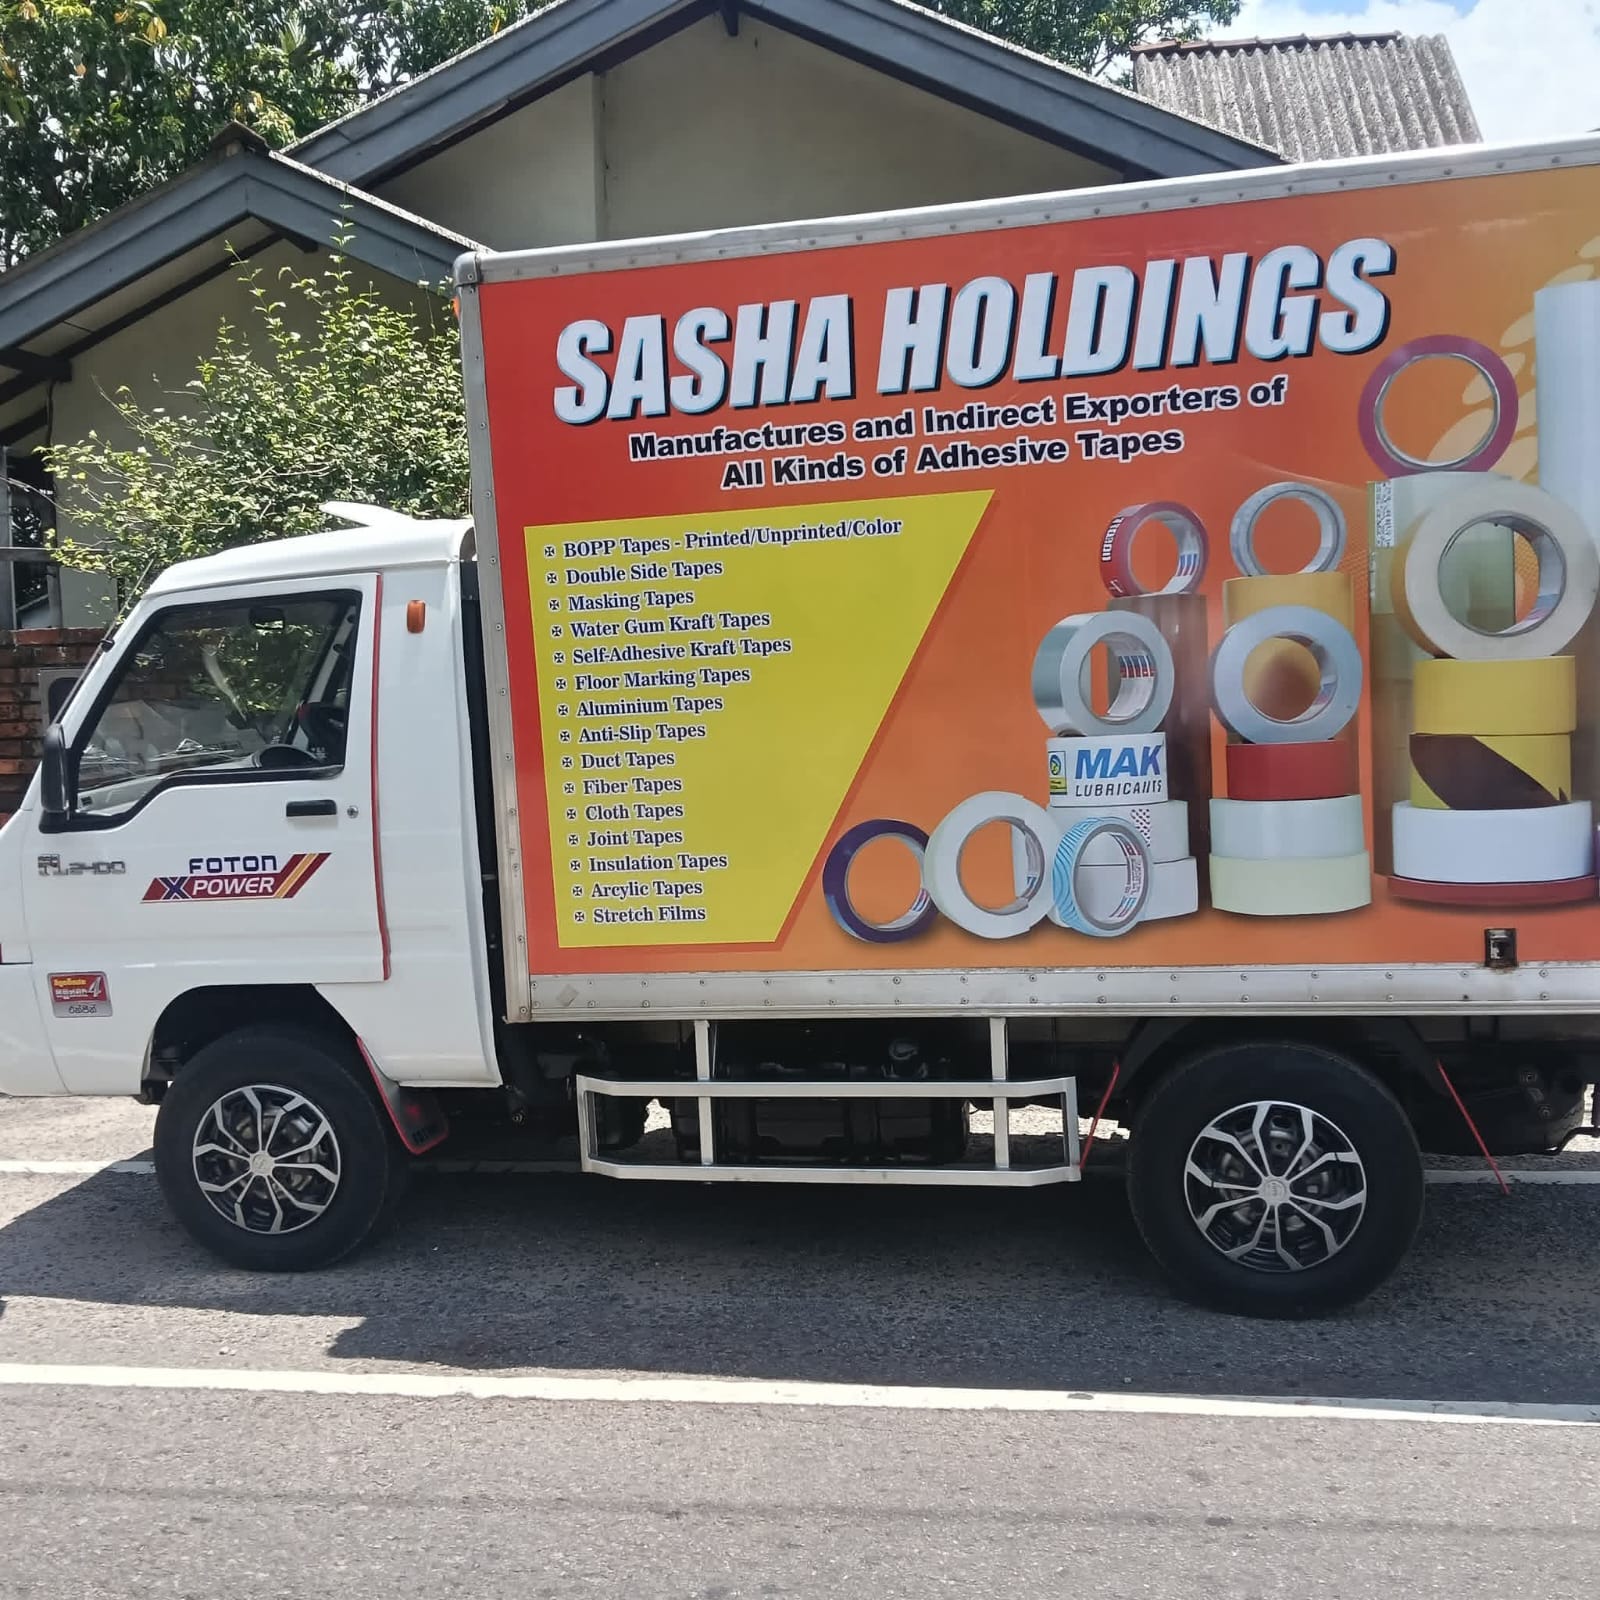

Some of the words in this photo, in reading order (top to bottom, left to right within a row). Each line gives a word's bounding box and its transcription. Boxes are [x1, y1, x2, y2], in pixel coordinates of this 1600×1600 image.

[553, 293, 854, 426] SASHA
[876, 237, 1395, 396] HOLDINGS
[630, 423, 845, 464] Manufactures
[855, 411, 913, 439] and
[925, 399, 1054, 433] Indirect
[1066, 387, 1238, 423] Exporters
[1250, 377, 1286, 404] of
[723, 461, 763, 488] All
[773, 454, 864, 484] Kinds
[874, 448, 906, 475] of
[916, 438, 1067, 471] Adhesive
[1077, 432, 1182, 461] Tapes
[563, 539, 616, 558] BOPP
[619, 538, 671, 556] Tapes
[684, 518, 902, 549] Printed/Unprinted/Color
[565, 566, 626, 585] Double
[630, 563, 668, 580] Side
[671, 561, 723, 580] Tapes
[567, 592, 641, 611] Masking
[643, 590, 694, 609] Tapes
[569, 621, 620, 638] Water
[624, 619, 665, 635] Gum
[668, 613, 716, 632] Kraft
[718, 612, 770, 631] Tapes
[573, 643, 686, 664] Self-Adhesive
[689, 639, 737, 657] Kraft
[739, 638, 792, 657] Tapes
[575, 674, 620, 691] Floor
[623, 669, 696, 688] Marking
[699, 668, 751, 686] Tapes
[577, 698, 669, 717] Aluminium
[672, 696, 723, 714] Tapes
[578, 724, 652, 744] Anti-Slip
[655, 723, 706, 742] Tapes
[580, 752, 622, 769] Duct
[624, 751, 675, 770] Tapes
[1075, 745, 1162, 779] MAK
[582, 779, 629, 795] Fiber
[631, 777, 682, 795] Tapes
[585, 804, 630, 821] Cloth
[633, 803, 684, 822] Tapes
[587, 830, 630, 847] Joint
[632, 829, 683, 848] Tapes
[188, 854, 278, 875] FOTON
[589, 855, 674, 872] Insulation
[677, 854, 728, 872] Tapes
[591, 881, 649, 900] Arcylic
[652, 880, 703, 899] Tapes
[593, 906, 654, 923] Stretch
[658, 905, 706, 921] Films
